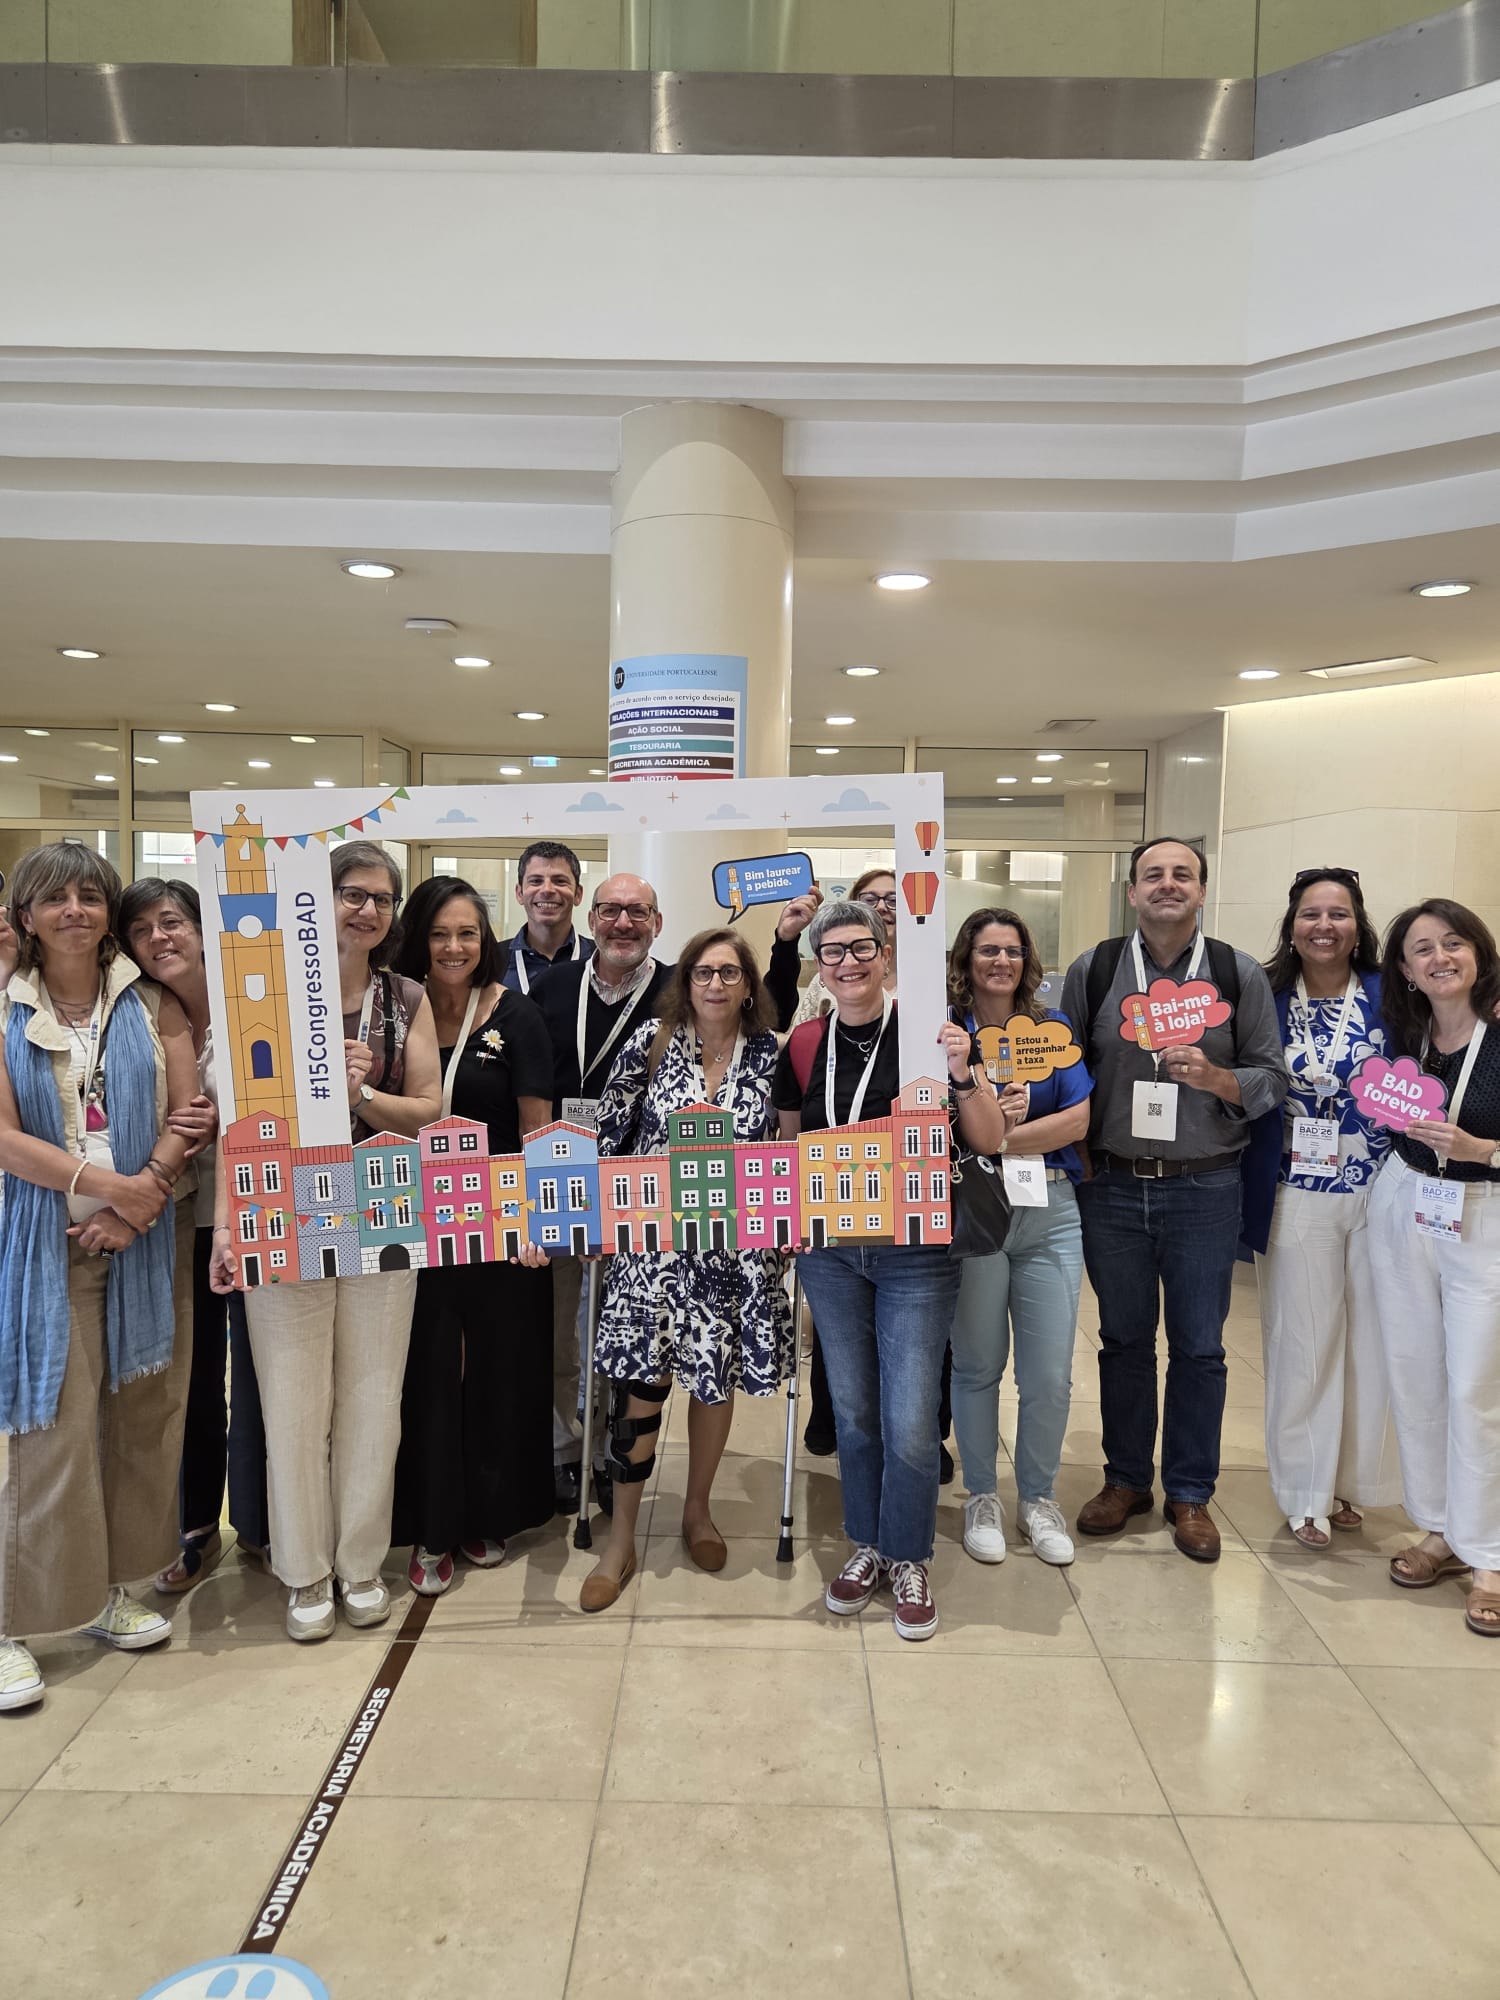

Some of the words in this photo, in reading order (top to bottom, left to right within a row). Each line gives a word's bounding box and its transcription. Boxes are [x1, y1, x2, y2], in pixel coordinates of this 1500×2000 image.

[675, 694, 701, 702] serviço
[612, 711, 640, 722] RELAÇÕES
[641, 709, 719, 717] INTERNACIONAIS
[628, 726, 648, 735] AÇÃO
[650, 725, 684, 733] SOCIAL
[629, 742, 681, 751] TESOURARIA
[614, 759, 652, 769] SECRETARIA
[654, 757, 710, 767] ACADÉMICA
[744, 871, 765, 881] Bim
[766, 866, 801, 878] laurear
[754, 879, 792, 892] pebide.
[295, 891, 331, 1100] #15CongressoBAD
[1149, 994, 1212, 1017] Bai-me
[1154, 1017, 1165, 1032] à
[1167, 1010, 1207, 1030] loja!
[1015, 1036, 1041, 1045] Estou
[1016, 1044, 1067, 1056] arreganhar
[1024, 1056, 1044, 1064] taxa
[1381, 1072, 1423, 1100] BAD
[1363, 1082, 1430, 1121] forever
[322, 1687, 391, 1798] SECRETARIA
[252, 1800, 335, 1941] ACADÉMICA
